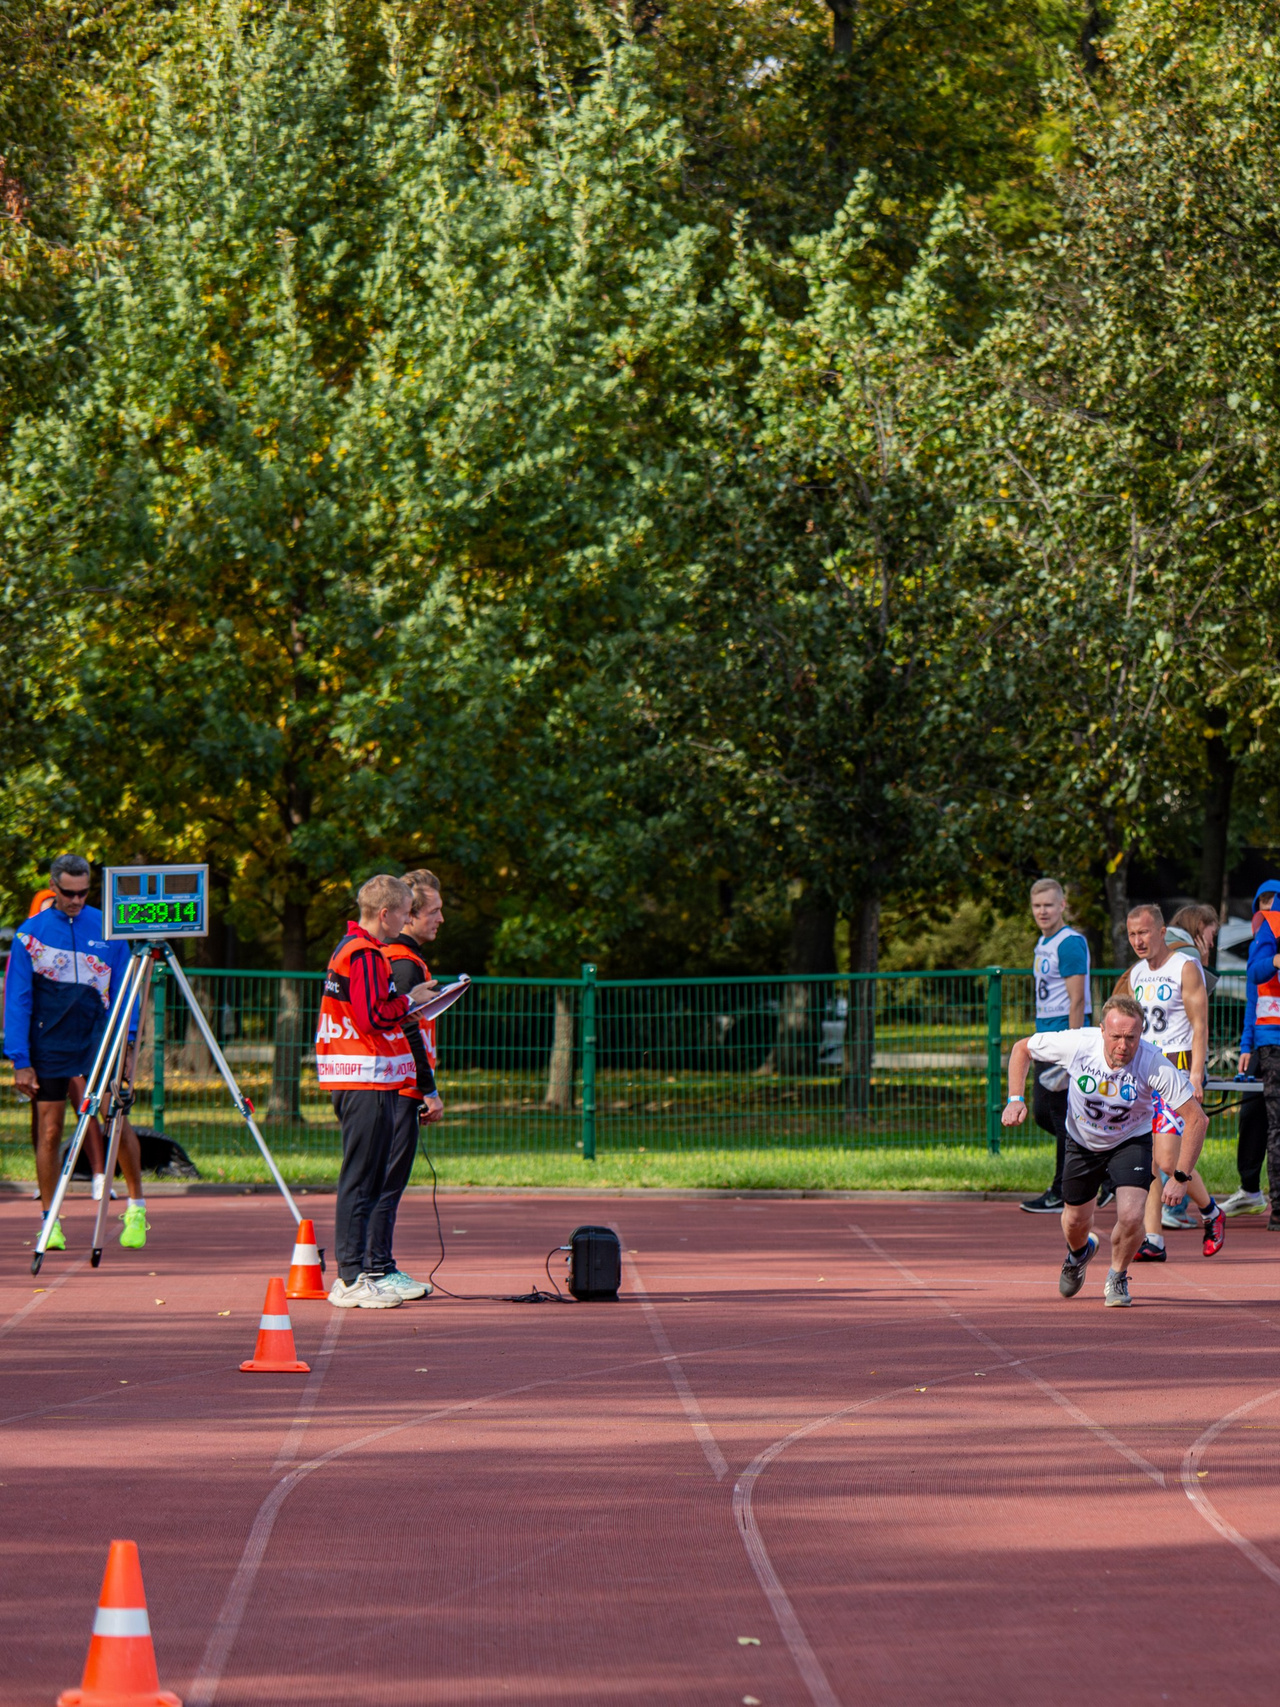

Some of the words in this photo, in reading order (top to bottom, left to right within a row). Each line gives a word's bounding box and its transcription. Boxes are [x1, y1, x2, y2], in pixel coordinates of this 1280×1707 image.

[118, 901, 196, 924] 12:39.14
[335, 1063, 363, 1076] СПОРТ
[1080, 1064, 1137, 1085] VMARAFONE
[1083, 1098, 1131, 1123] 52
